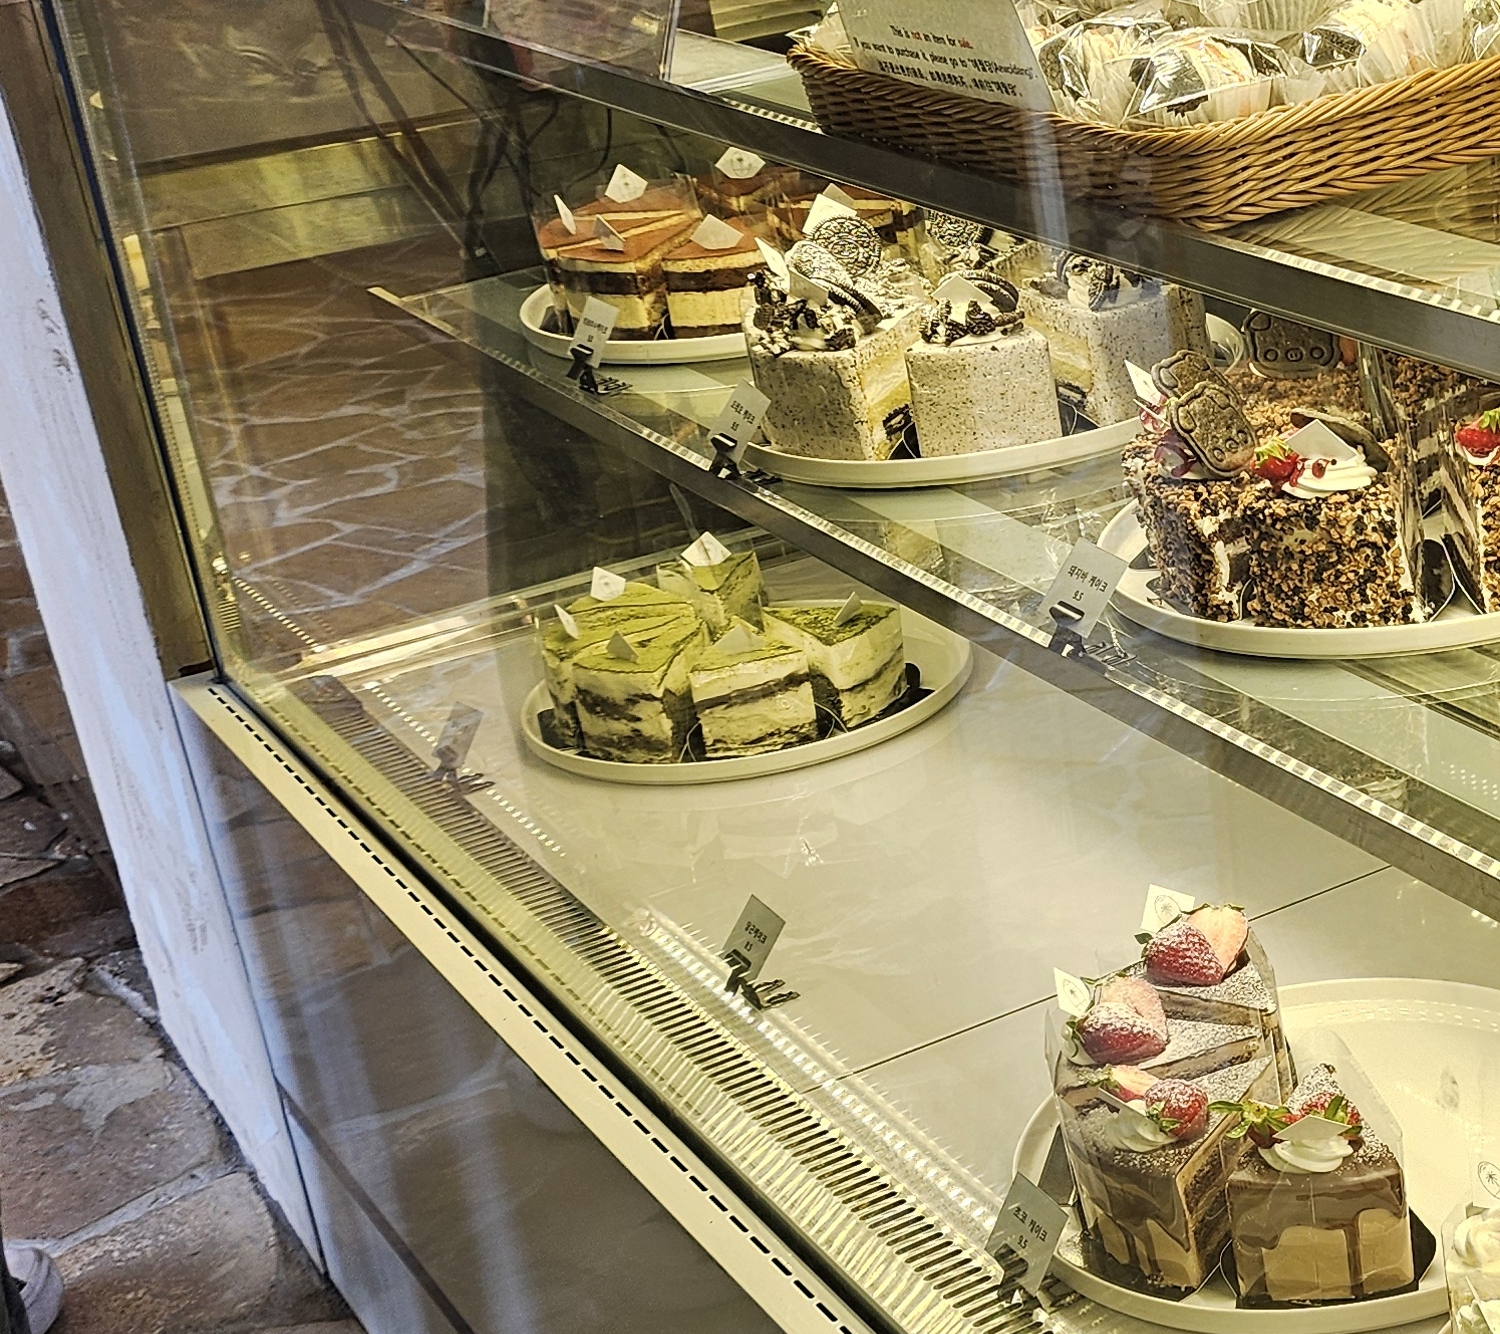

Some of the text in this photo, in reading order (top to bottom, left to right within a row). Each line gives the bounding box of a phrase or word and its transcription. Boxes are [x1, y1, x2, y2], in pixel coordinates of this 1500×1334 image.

[1012, 1206, 1048, 1243] 초코 케이크
[1017, 1234, 1029, 1251] 9.5
